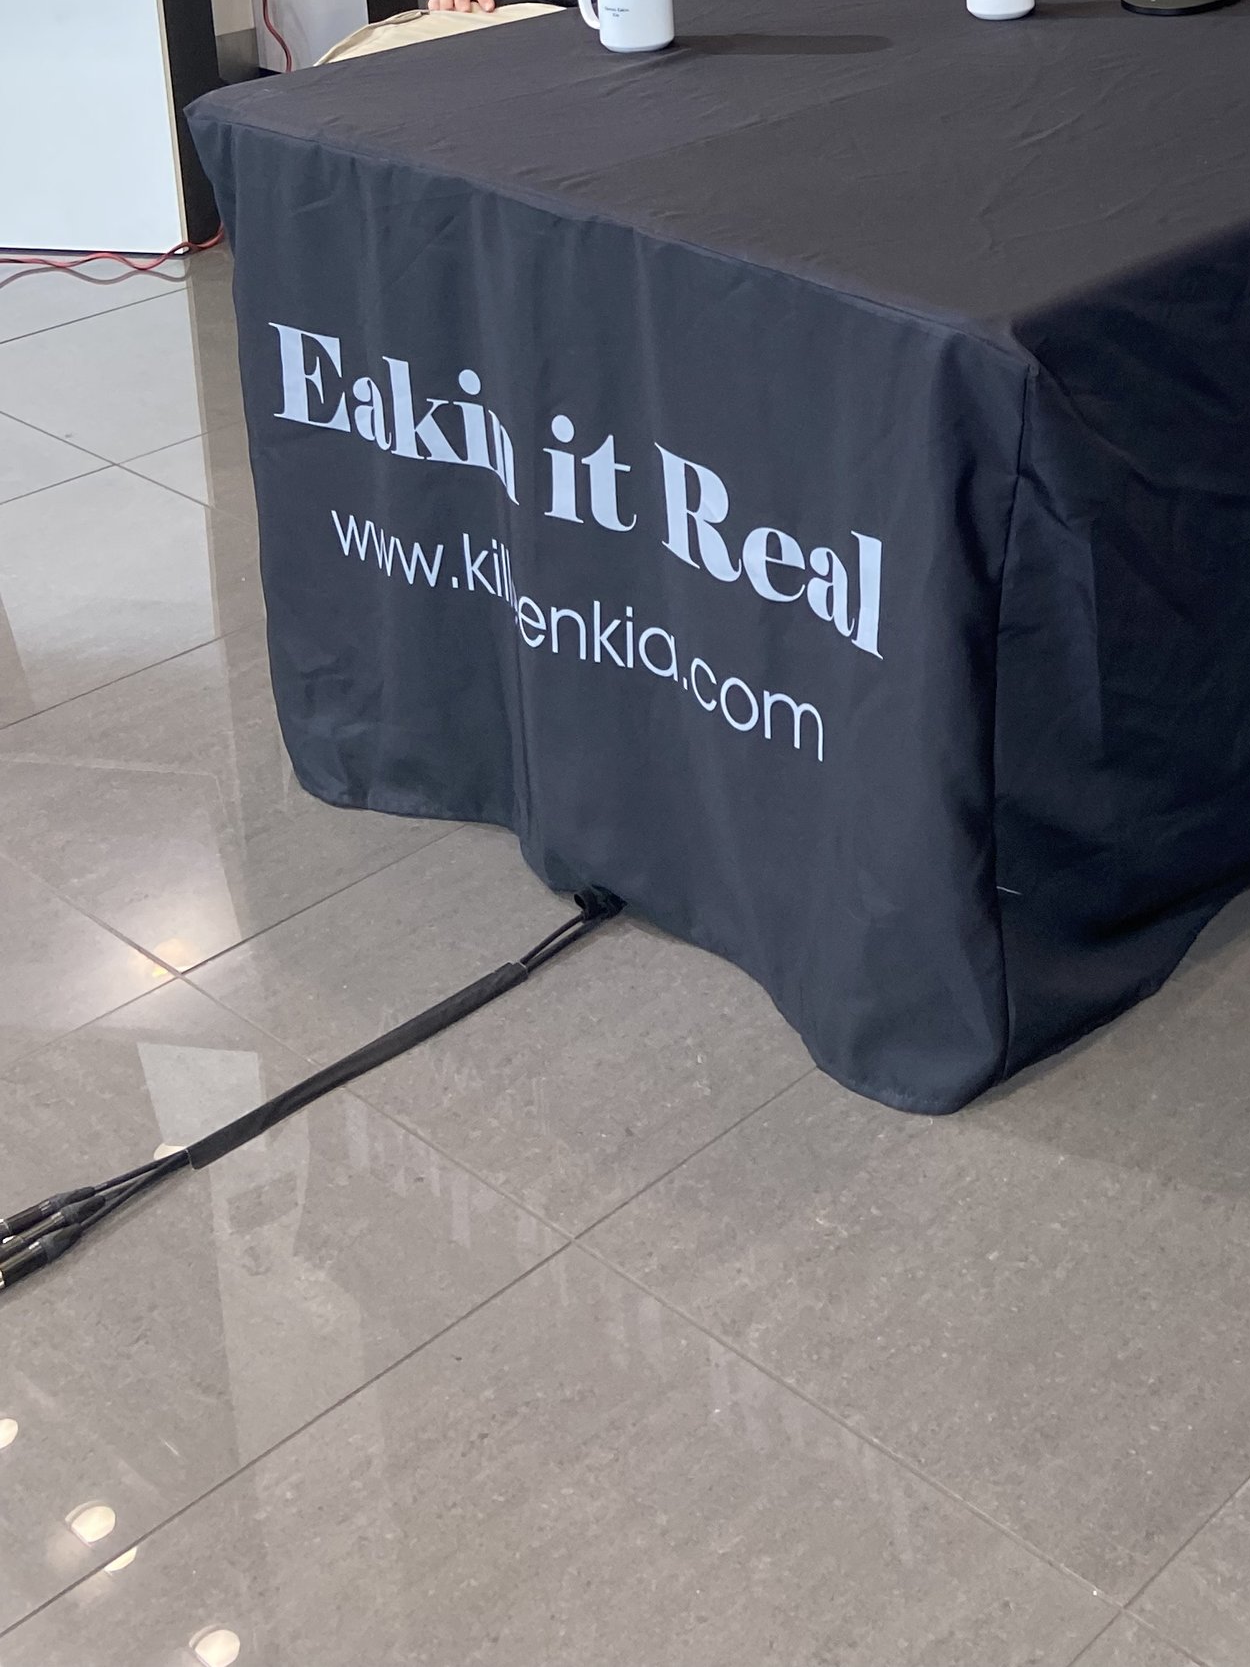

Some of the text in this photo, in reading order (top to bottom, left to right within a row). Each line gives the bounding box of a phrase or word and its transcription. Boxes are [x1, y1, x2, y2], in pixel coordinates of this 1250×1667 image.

[268, 321, 884, 661] Eakin it Real
[331, 509, 825, 763] www.killenkia.com
